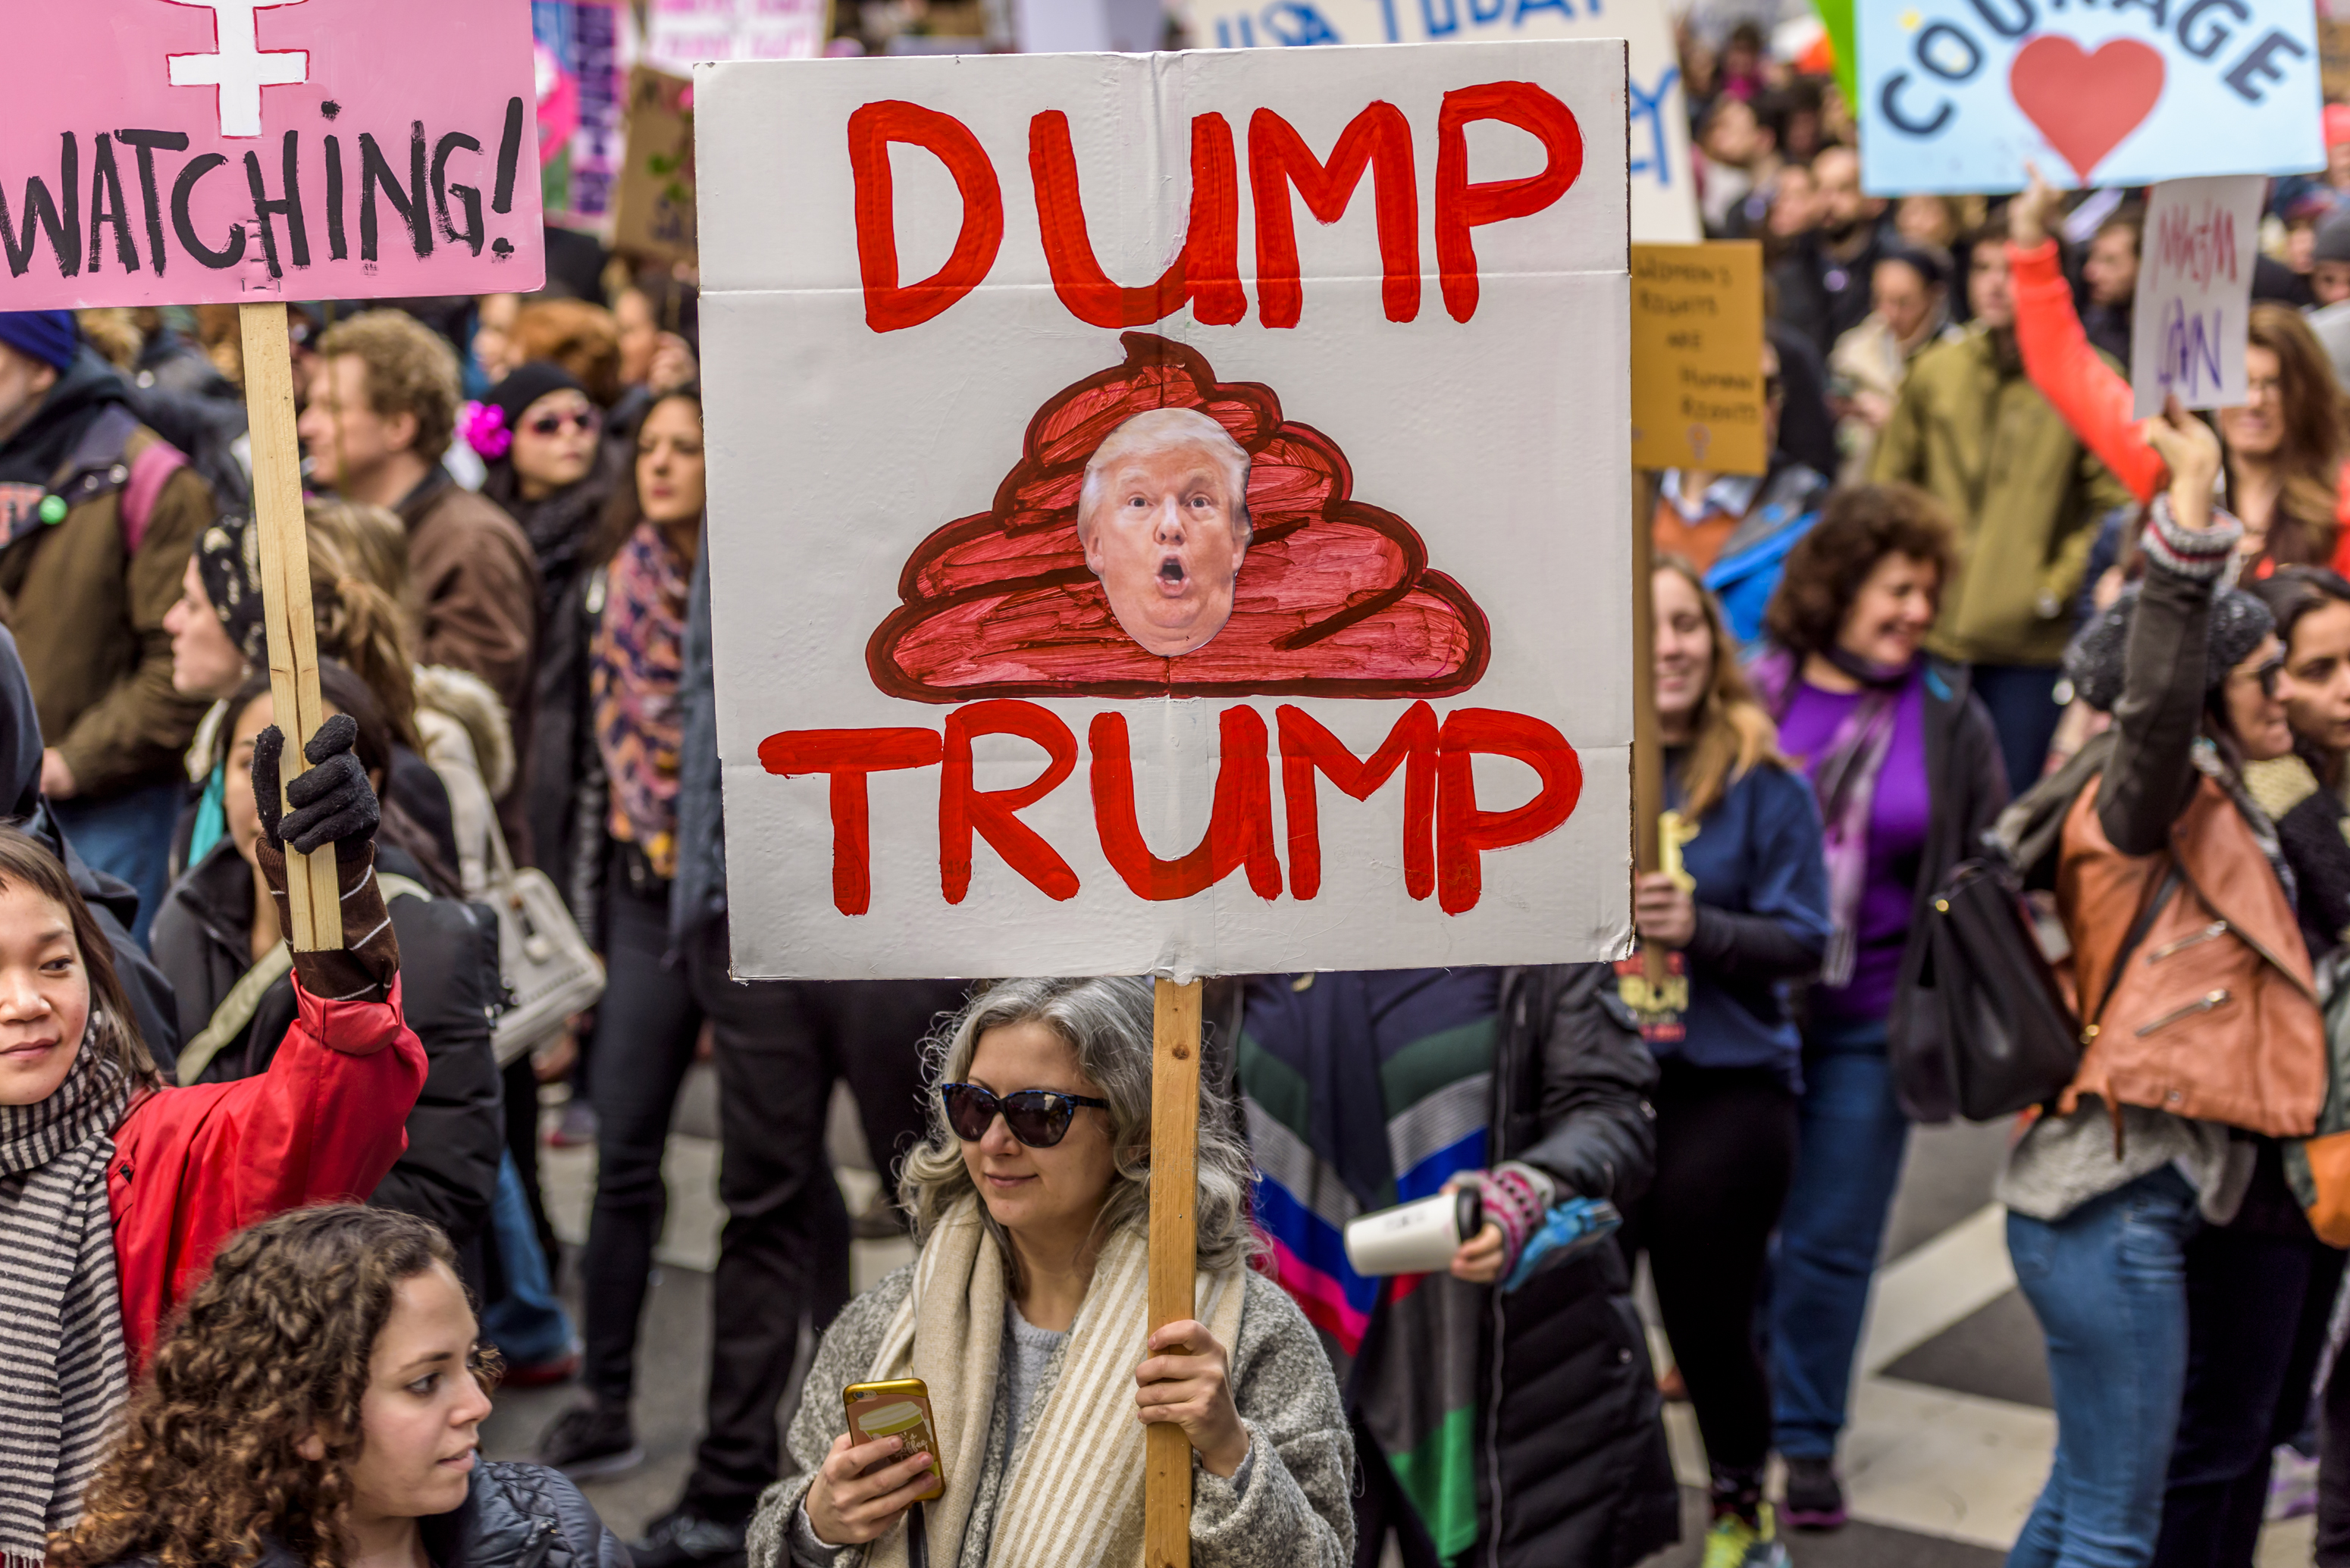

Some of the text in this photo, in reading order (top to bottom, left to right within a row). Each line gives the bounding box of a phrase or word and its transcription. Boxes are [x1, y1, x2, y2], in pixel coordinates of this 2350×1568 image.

[1880, 0, 2308, 137] COUGE
[848, 80, 1585, 333] DUMP
[758, 699, 1584, 917] TRUMP
